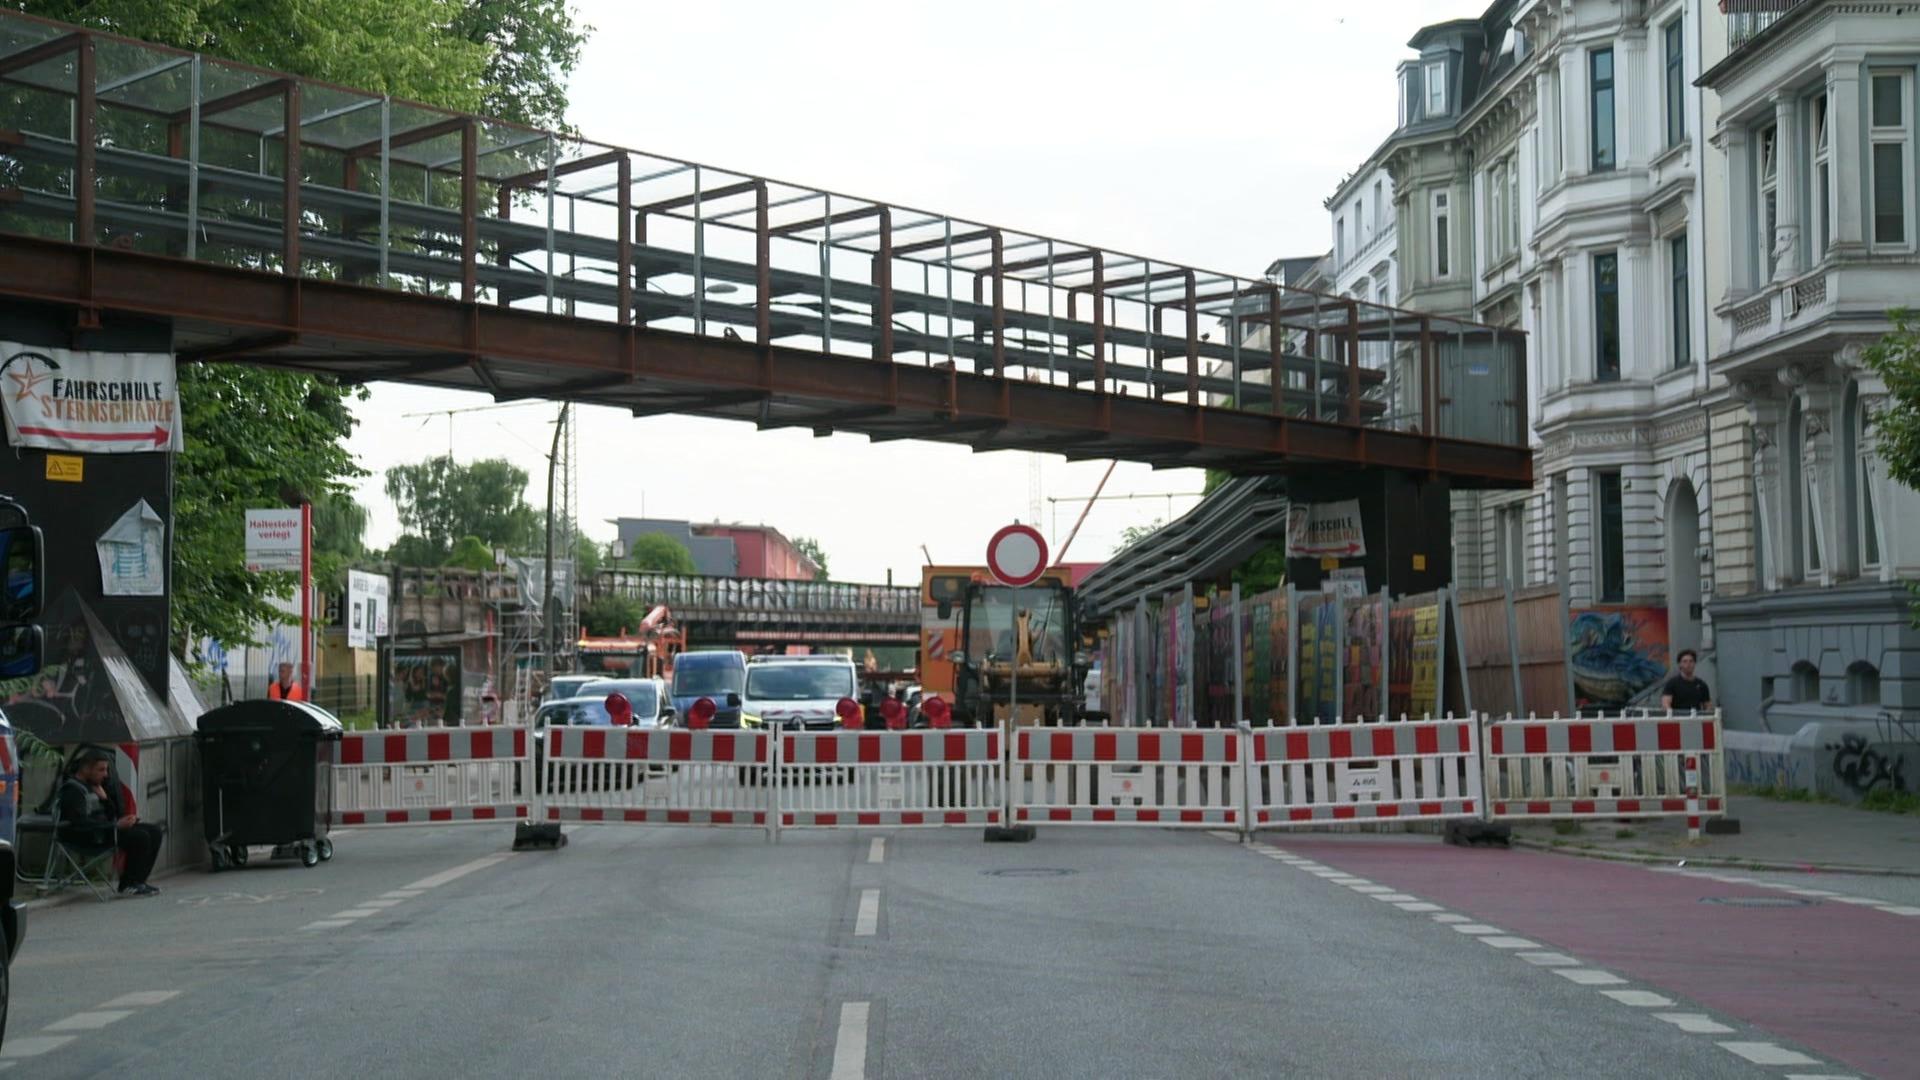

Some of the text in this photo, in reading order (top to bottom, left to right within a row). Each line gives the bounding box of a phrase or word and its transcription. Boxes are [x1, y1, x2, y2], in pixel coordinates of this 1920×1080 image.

[52, 378, 162, 401] FAHRSCHULE
[40, 395, 174, 423] STERNSCHANZE
[249, 519, 298, 529] Haltestelle
[258, 530, 291, 540] verlegt
